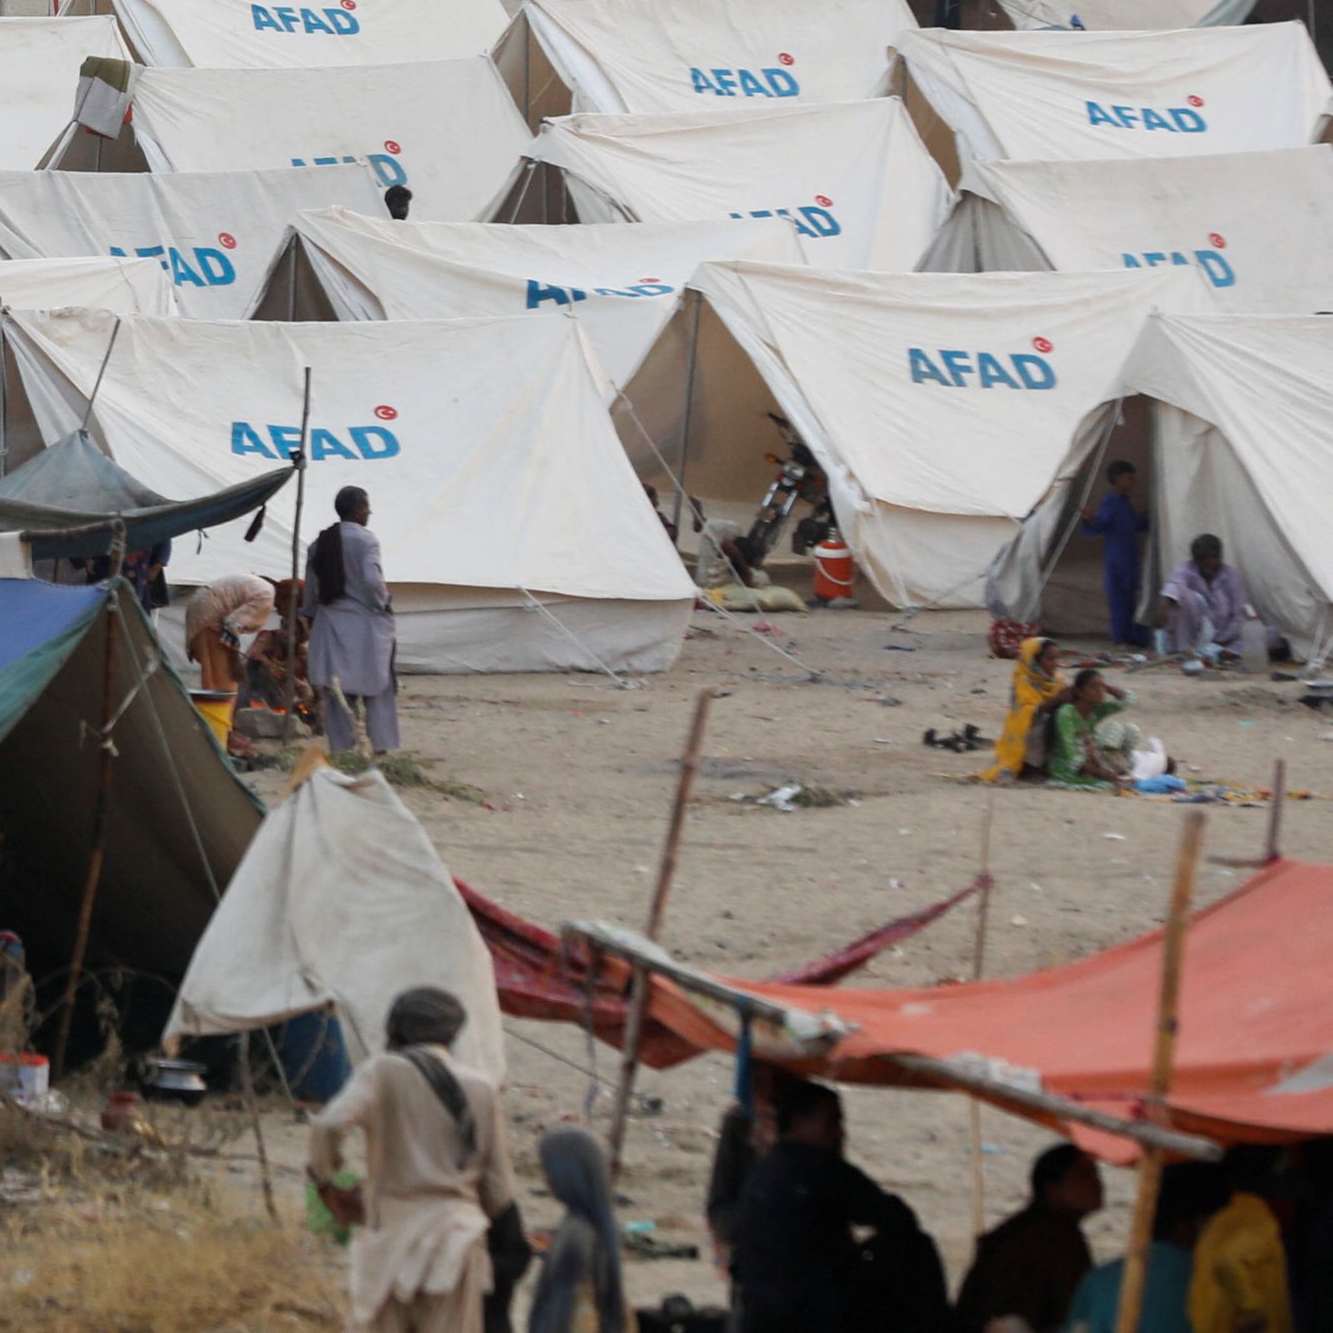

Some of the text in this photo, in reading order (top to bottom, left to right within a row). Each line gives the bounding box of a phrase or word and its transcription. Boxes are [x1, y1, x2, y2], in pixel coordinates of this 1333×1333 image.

[251, 4, 360, 35] AFAD
[690, 68, 800, 98] AFAD
[1085, 101, 1207, 133] AFAD
[909, 348, 1056, 390] AFAD
[231, 422, 401, 461] AFAD
